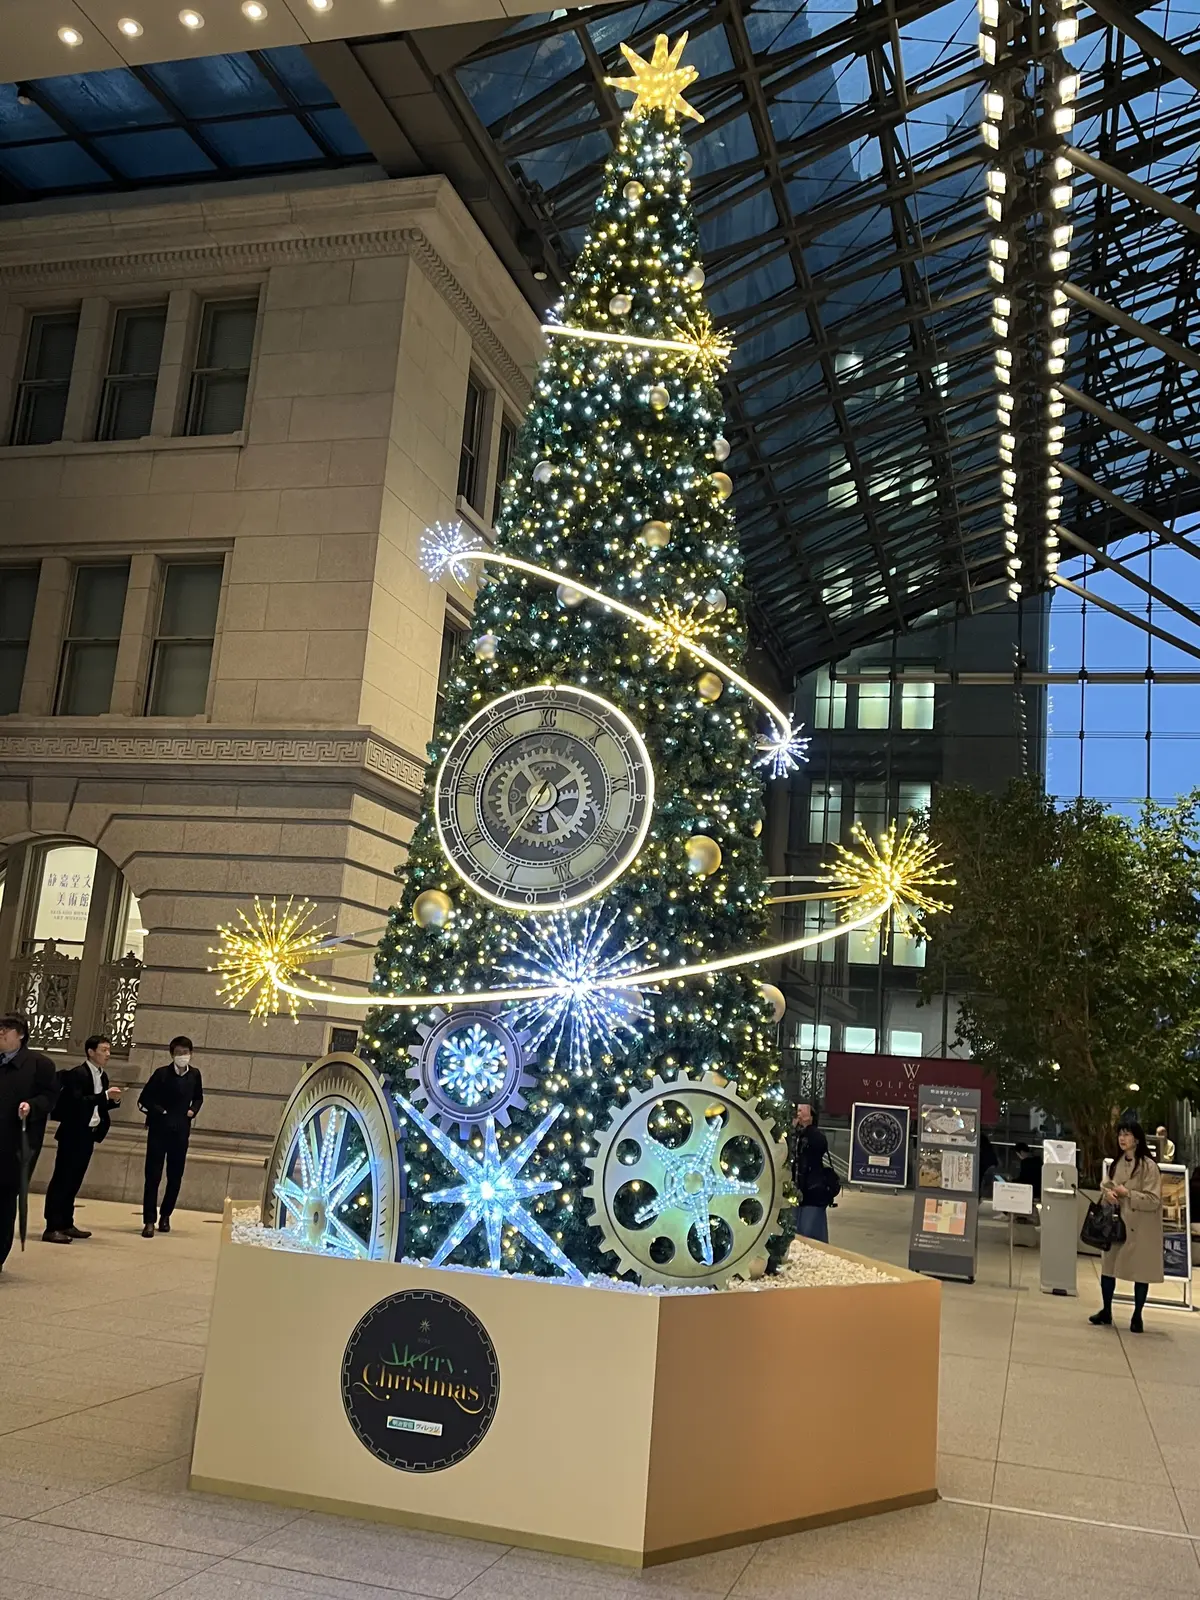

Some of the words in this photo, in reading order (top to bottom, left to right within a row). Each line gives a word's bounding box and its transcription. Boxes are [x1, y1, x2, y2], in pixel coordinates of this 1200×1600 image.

[515, 694, 526, 706] 19
[543, 690, 558, 701] 20
[486, 707, 499, 720] 18
[538, 709, 557, 728] XC
[600, 708, 611, 720] 2
[462, 728, 474, 741] 17
[584, 725, 605, 747] X
[621, 732, 632, 743] 3
[446, 757, 459, 768] 16
[633, 761, 645, 770] 4
[610, 772, 629, 795] XX
[439, 787, 450, 798] 15
[635, 793, 646, 802] 5
[440, 817, 452, 831] 14
[469, 872, 482, 883] 12
[588, 874, 598, 887] 8
[496, 885, 507, 899] 11
[525, 892, 538, 905] 10
[56, 892, 89, 907] 美術館
[354, 1363, 485, 1413] Christmas
